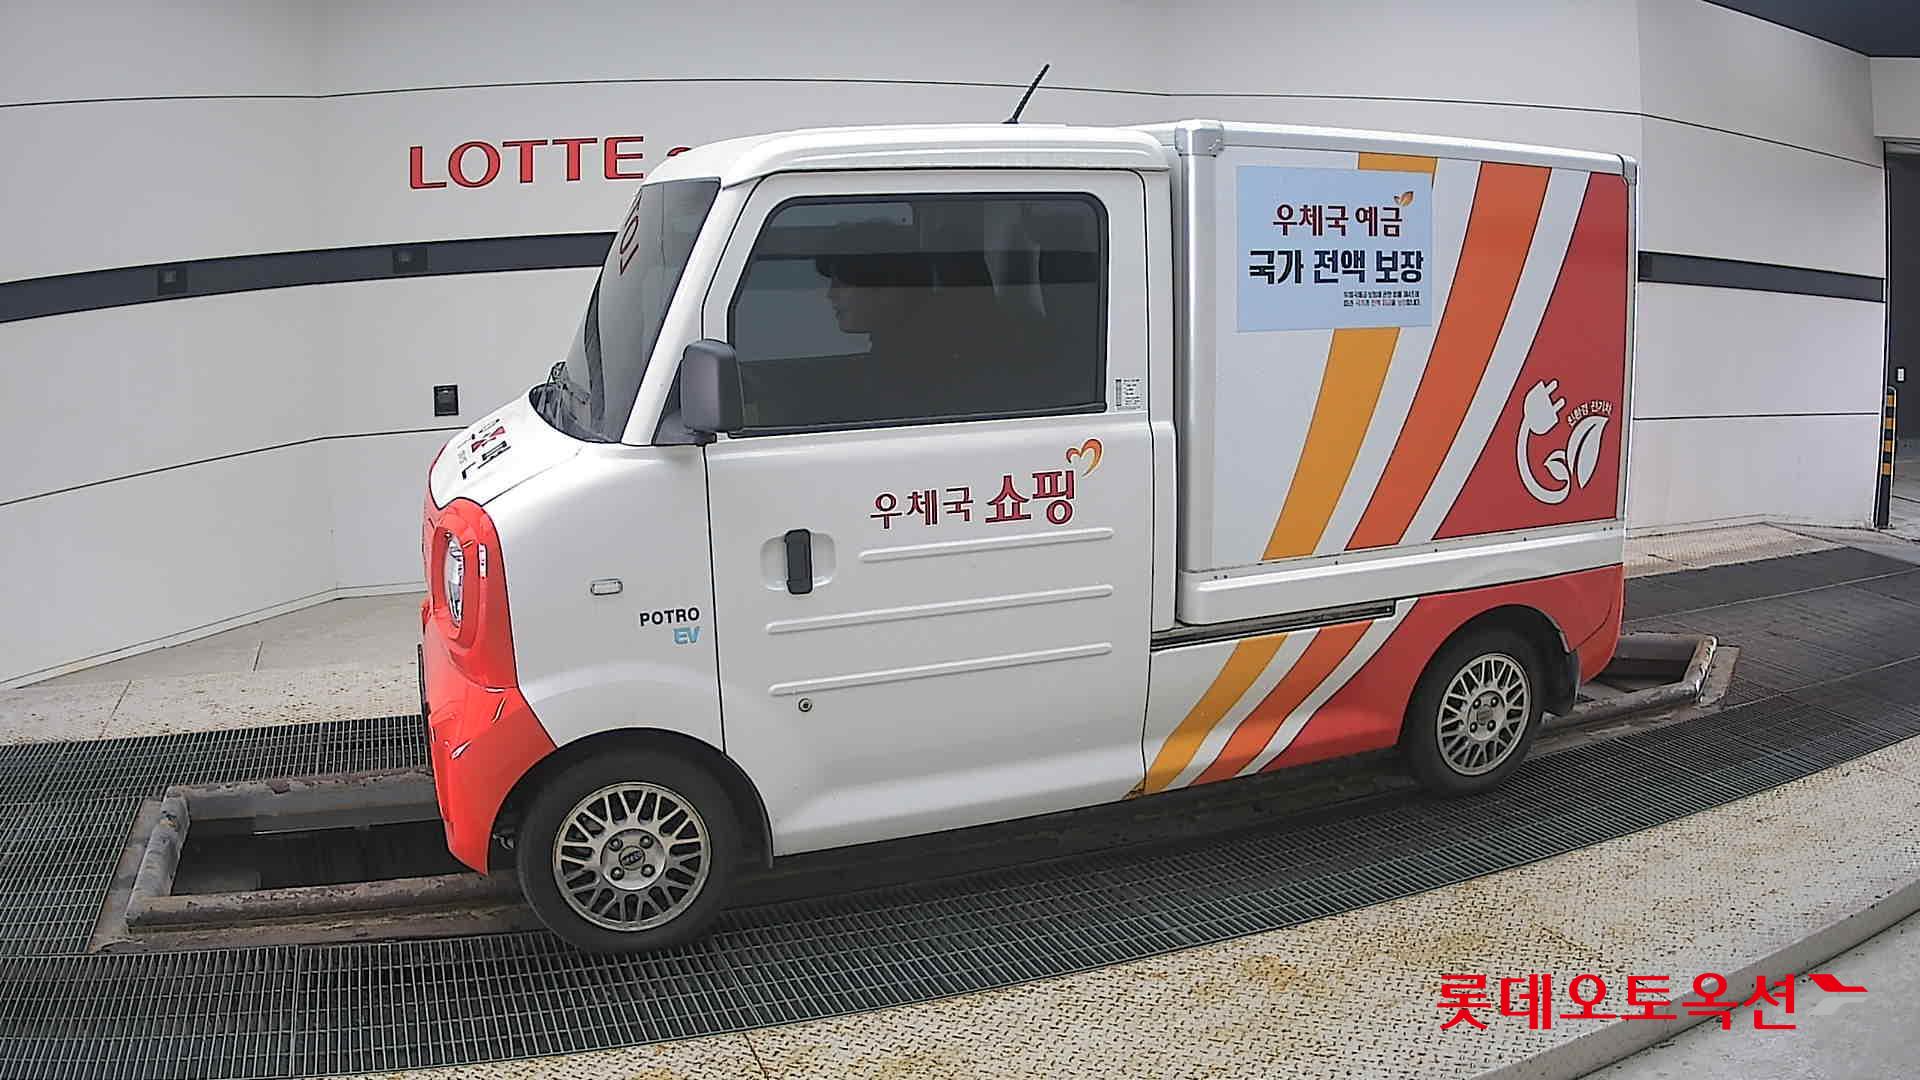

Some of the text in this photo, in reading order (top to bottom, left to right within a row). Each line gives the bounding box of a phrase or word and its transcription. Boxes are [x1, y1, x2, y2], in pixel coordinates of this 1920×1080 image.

[409, 135, 645, 190] LOTTE
[1272, 203, 1403, 237] 우체국 예금
[1249, 249, 1424, 285] 국가 전액 보장
[869, 469, 1075, 529] 우체국 쇼핑
[639, 607, 700, 627] POTRO
[673, 626, 701, 645] EV
